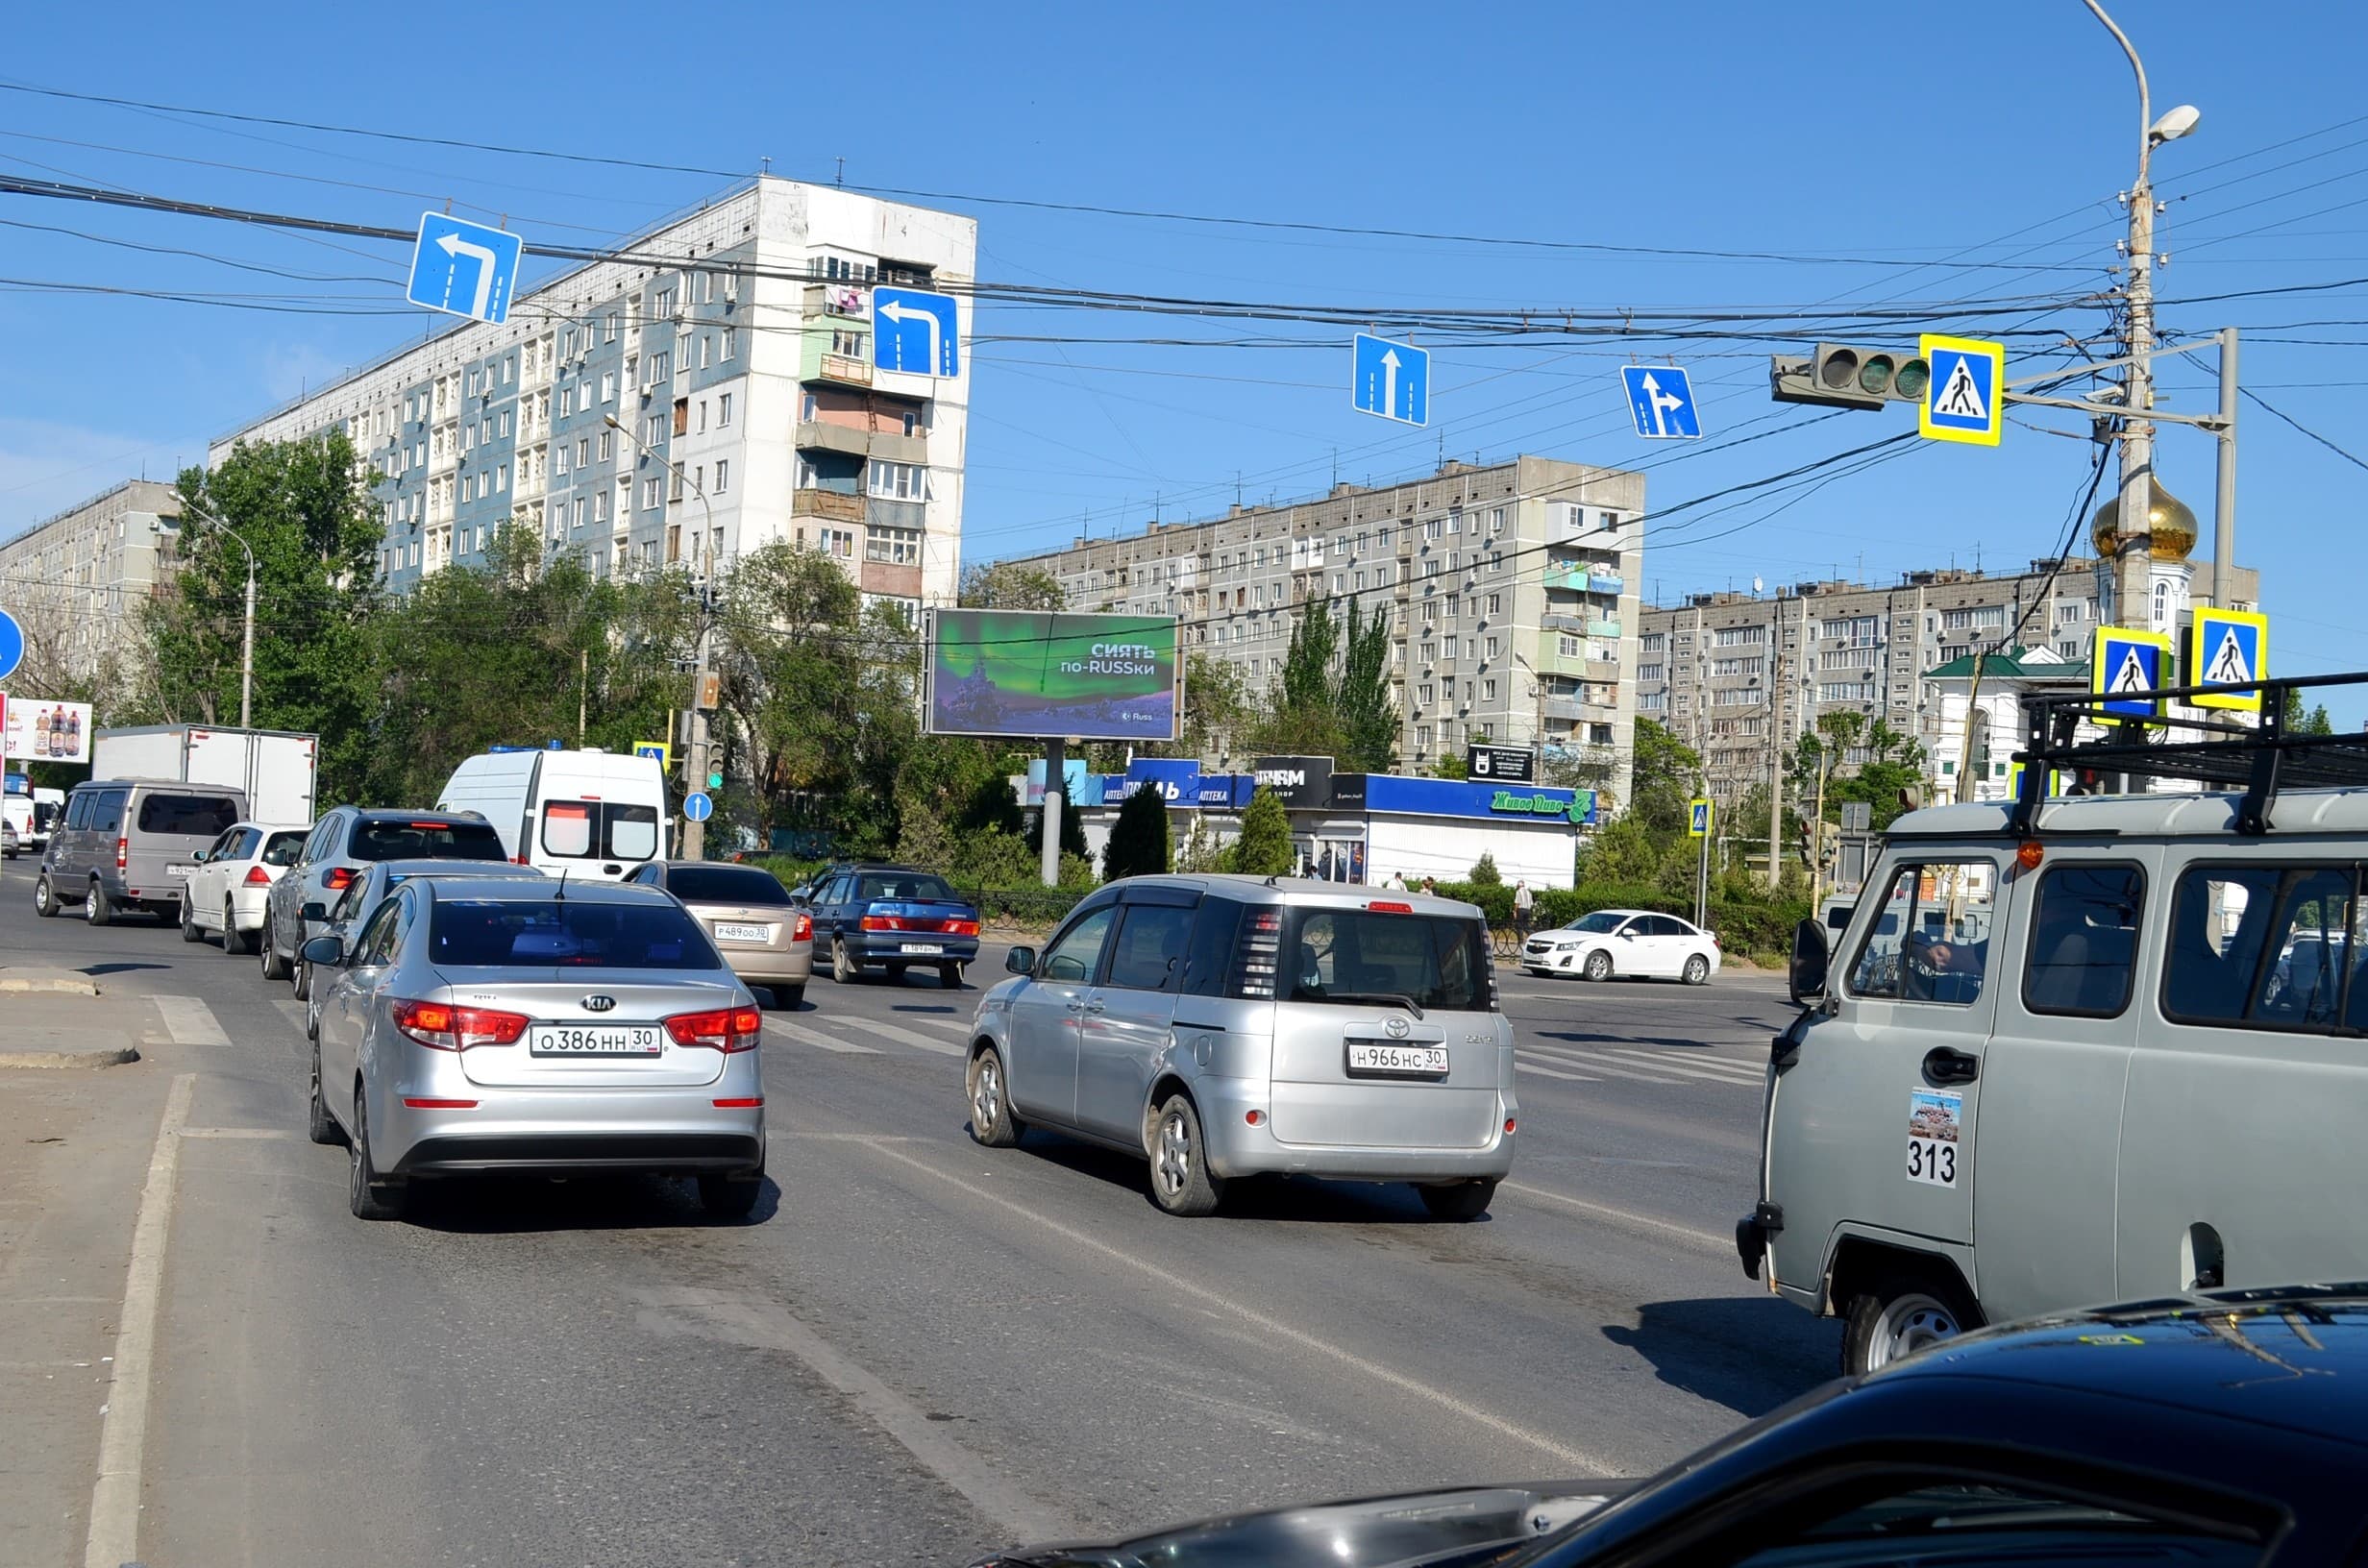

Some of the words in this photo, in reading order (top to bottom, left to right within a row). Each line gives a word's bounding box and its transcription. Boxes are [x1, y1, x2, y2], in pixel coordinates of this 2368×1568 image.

[1060, 660, 1154, 675] по-RUSSки
[1132, 713, 1152, 722] Russ
[1198, 791, 1227, 801] АПТЕКА
[1492, 792, 1533, 812] Живое
[1533, 795, 1565, 814] Пиво
[586, 997, 612, 1010] KIA
[632, 1030, 653, 1045] 30
[1425, 1050, 1442, 1065] 30
[1908, 1140, 1956, 1184] 313
